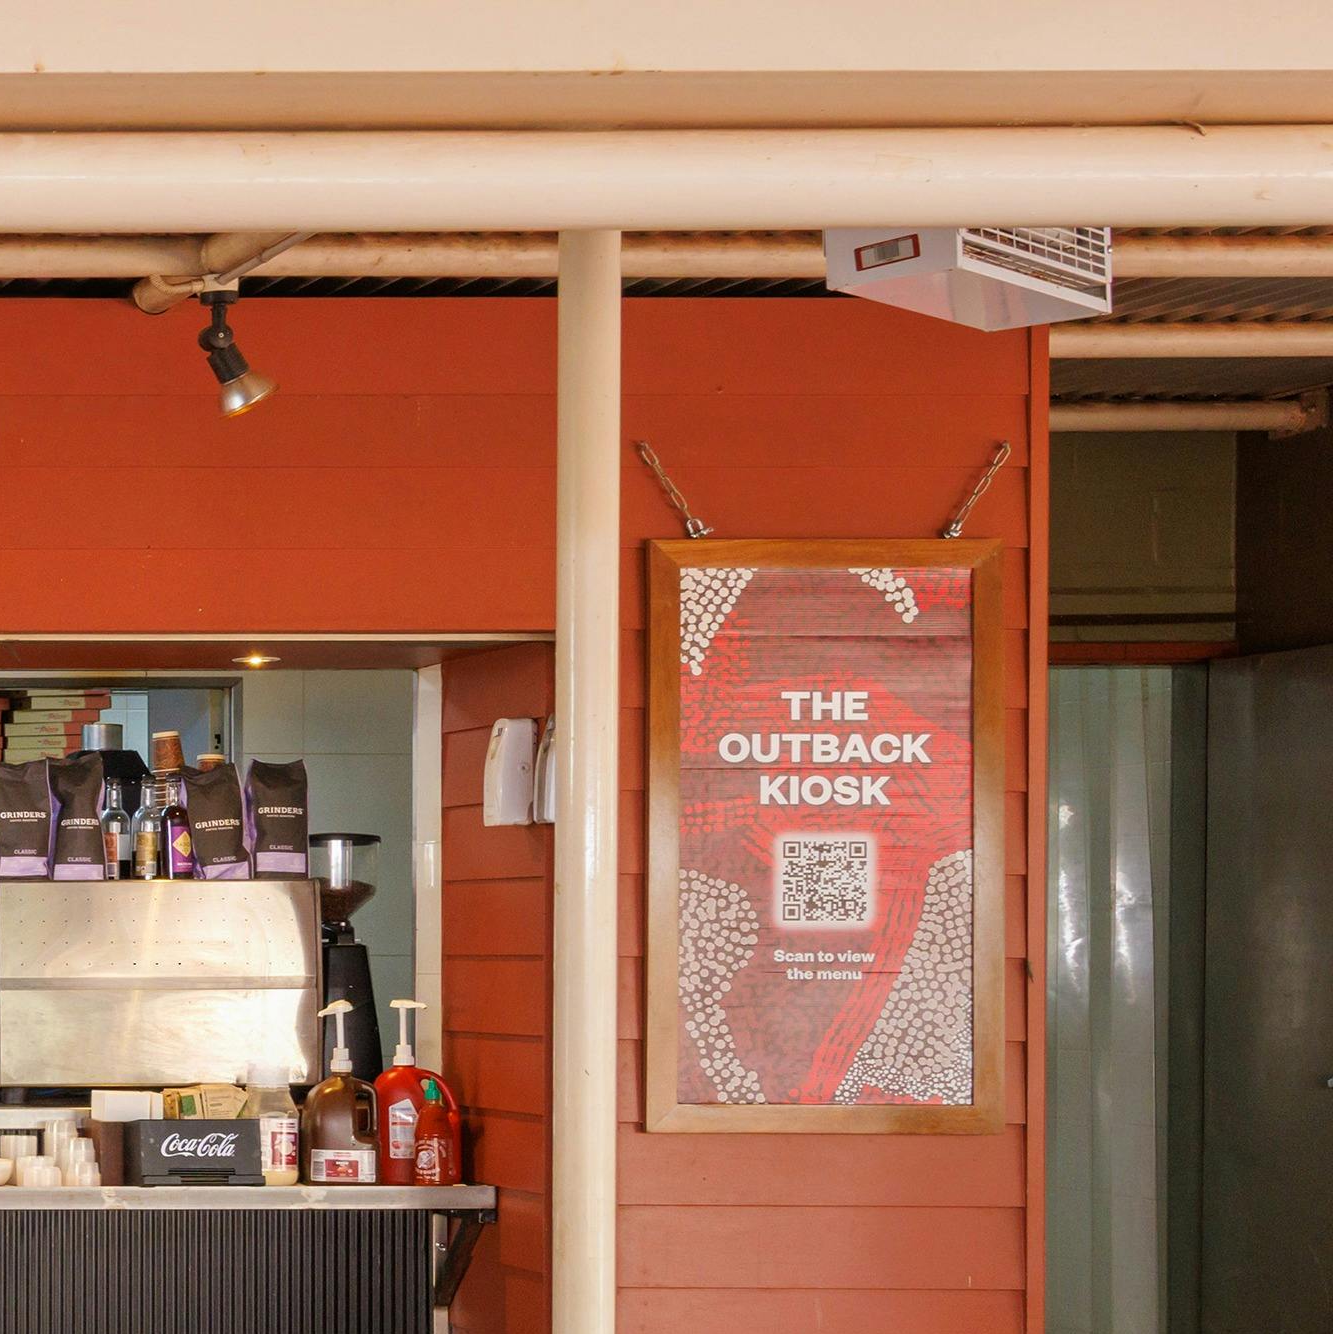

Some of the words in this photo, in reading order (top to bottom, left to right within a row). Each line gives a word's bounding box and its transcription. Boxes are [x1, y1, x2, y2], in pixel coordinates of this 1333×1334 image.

[781, 691, 868, 721] THE
[718, 733, 932, 763] OUTBACK
[759, 775, 891, 805] KIOSK
[0, 811, 47, 819] GRINDERS
[258, 806, 304, 815] GRINDERS
[195, 818, 240, 829] GRINDERS
[773, 949, 814, 962] Scan
[817, 950, 834, 962] to
[837, 950, 875, 962] view
[786, 967, 813, 980] the
[817, 970, 862, 980] menu
[161, 1132, 239, 1158] Coca-Cola
